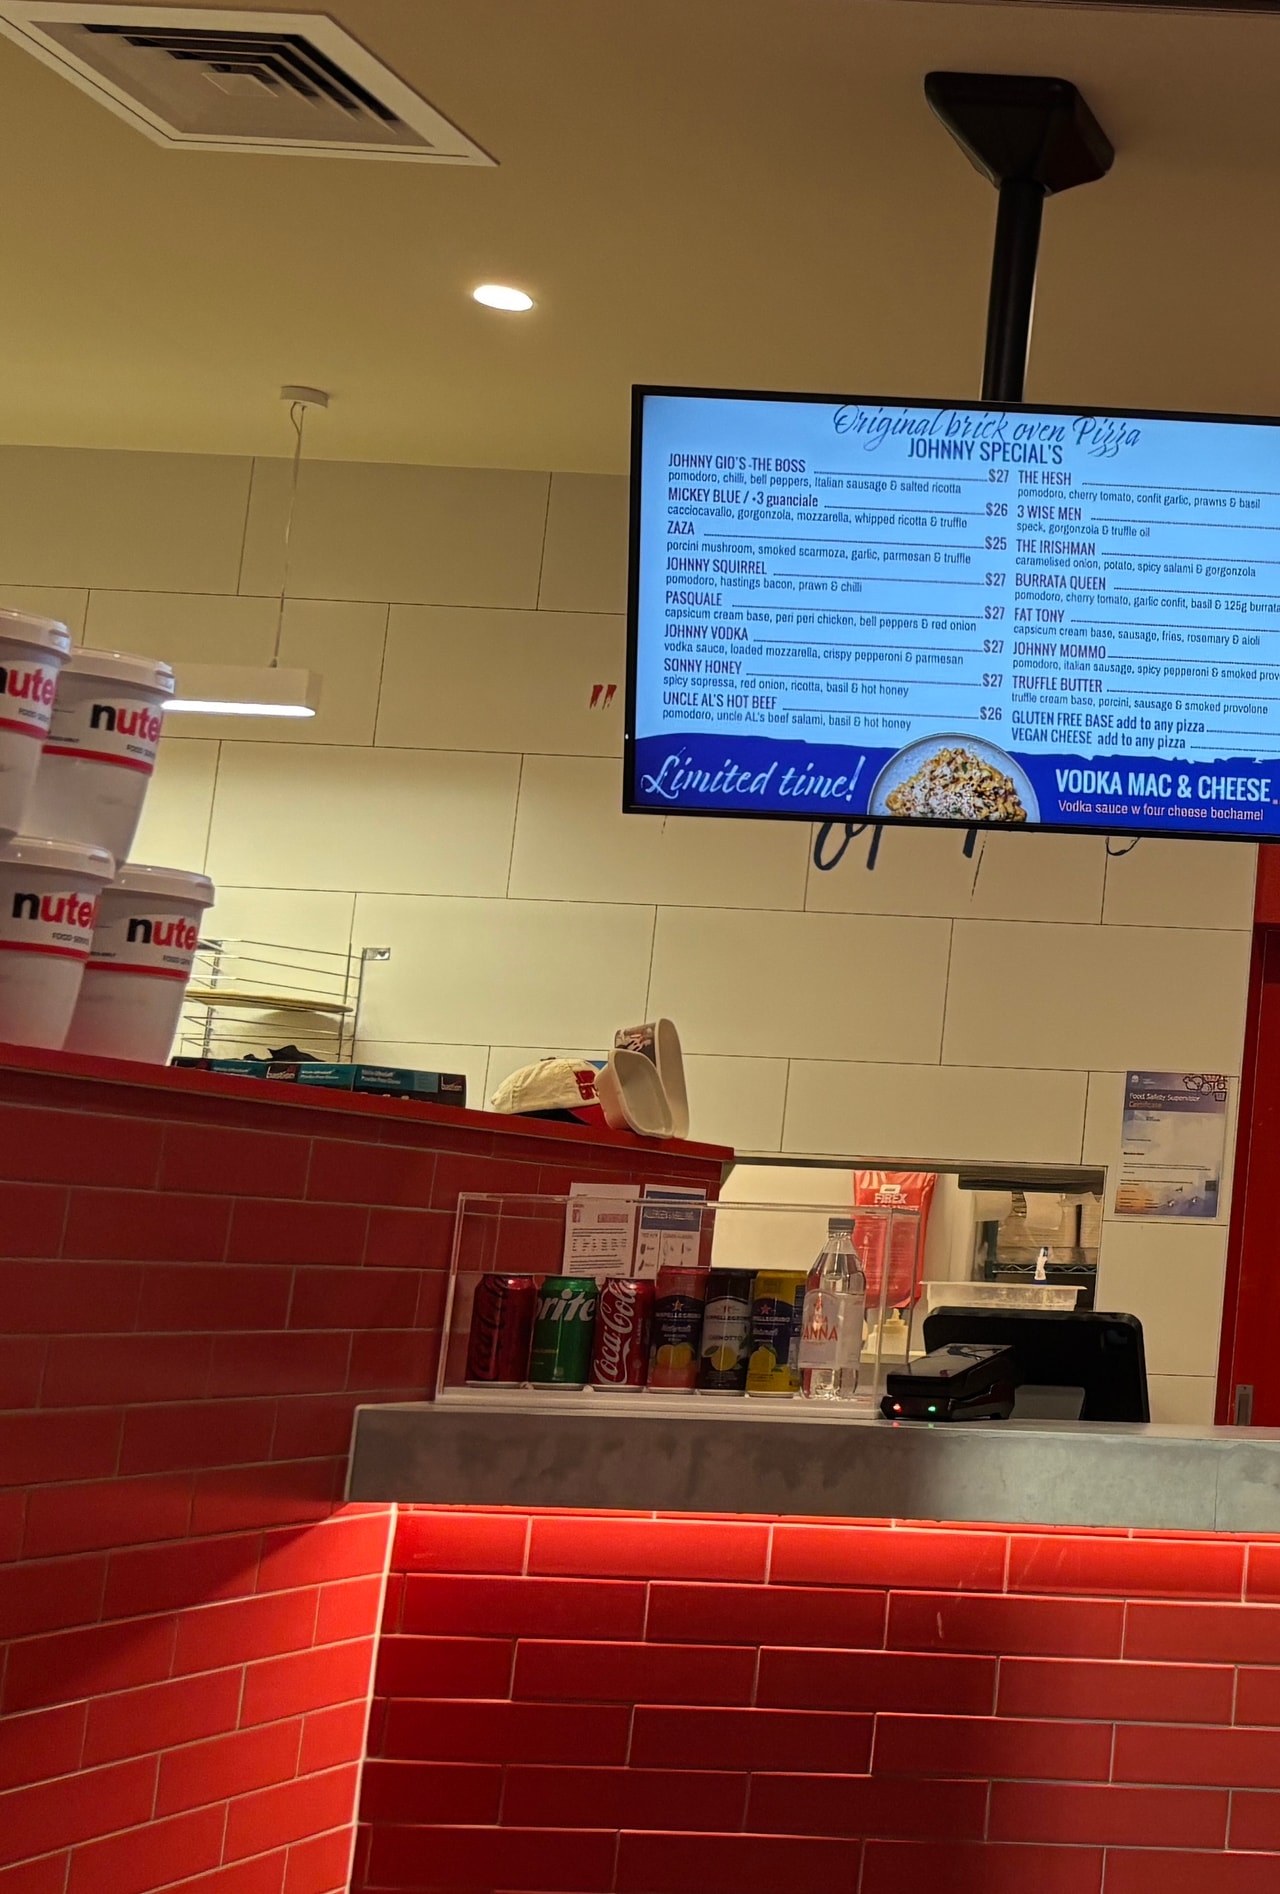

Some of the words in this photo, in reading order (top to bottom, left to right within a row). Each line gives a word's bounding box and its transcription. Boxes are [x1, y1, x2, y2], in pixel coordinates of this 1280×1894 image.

[833, 403, 946, 452] Original
[945, 410, 1009, 443] brick
[1013, 423, 1065, 442] oven
[1072, 416, 1143, 458] Pizza
[908, 438, 975, 460] JOHNNY
[979, 442, 1063, 465] SPECIAL'S
[667, 452, 713, 469] JOHNNY
[714, 454, 746, 470] GIO'S
[774, 457, 806, 473] BOSS
[987, 468, 1009, 483] $27
[1017, 469, 1039, 485] THE
[1041, 470, 1072, 486] HESH
[666, 519, 695, 535] ZAZA
[984, 535, 1007, 551] $25
[665, 555, 710, 573] JOHNNY
[711, 558, 767, 575] SQUIRREL
[984, 571, 1006, 587] $27
[665, 573, 717, 588] pomodoro,
[719, 575, 760, 590] hastings
[762, 576, 795, 591] bacon,
[798, 580, 828, 592] prawn
[829, 580, 838, 592] &
[1014, 572, 1067, 589] BURRATA
[1069, 574, 1106, 591] QUEEN
[664, 589, 723, 607] PASQUALE
[983, 604, 1005, 620] $27
[663, 622, 708, 639] JOHNNY
[710, 625, 749, 641] VODKA
[982, 638, 1004, 654] $27
[662, 690, 699, 706] UNCLE
[700, 692, 724, 708] AL'S
[726, 693, 749, 709] HOT
[751, 694, 778, 710] BEEF
[979, 705, 1002, 721] $26
[1011, 709, 1054, 726] GLUTEN
[1056, 711, 1083, 727] FREE
[1084, 713, 1114, 728] BASE
[1115, 715, 1137, 729] add
[1139, 716, 1151, 730] to
[1153, 719, 1174, 733] any
[1175, 718, 1205, 734] pizza
[641, 747, 778, 800] Limited
[778, 755, 866, 801] time!
[1055, 768, 1123, 795] VODKA
[1127, 771, 1172, 797] MAC
[1176, 774, 1192, 798] &
[1197, 775, 1271, 802] CHEESE
[1057, 799, 1092, 812] Vodka
[1094, 803, 1128, 814] sauce
[1130, 805, 1141, 815] w
[1142, 802, 1165, 816] four
[1167, 804, 1207, 818] cheese
[1210, 806, 1264, 821] bechamel
